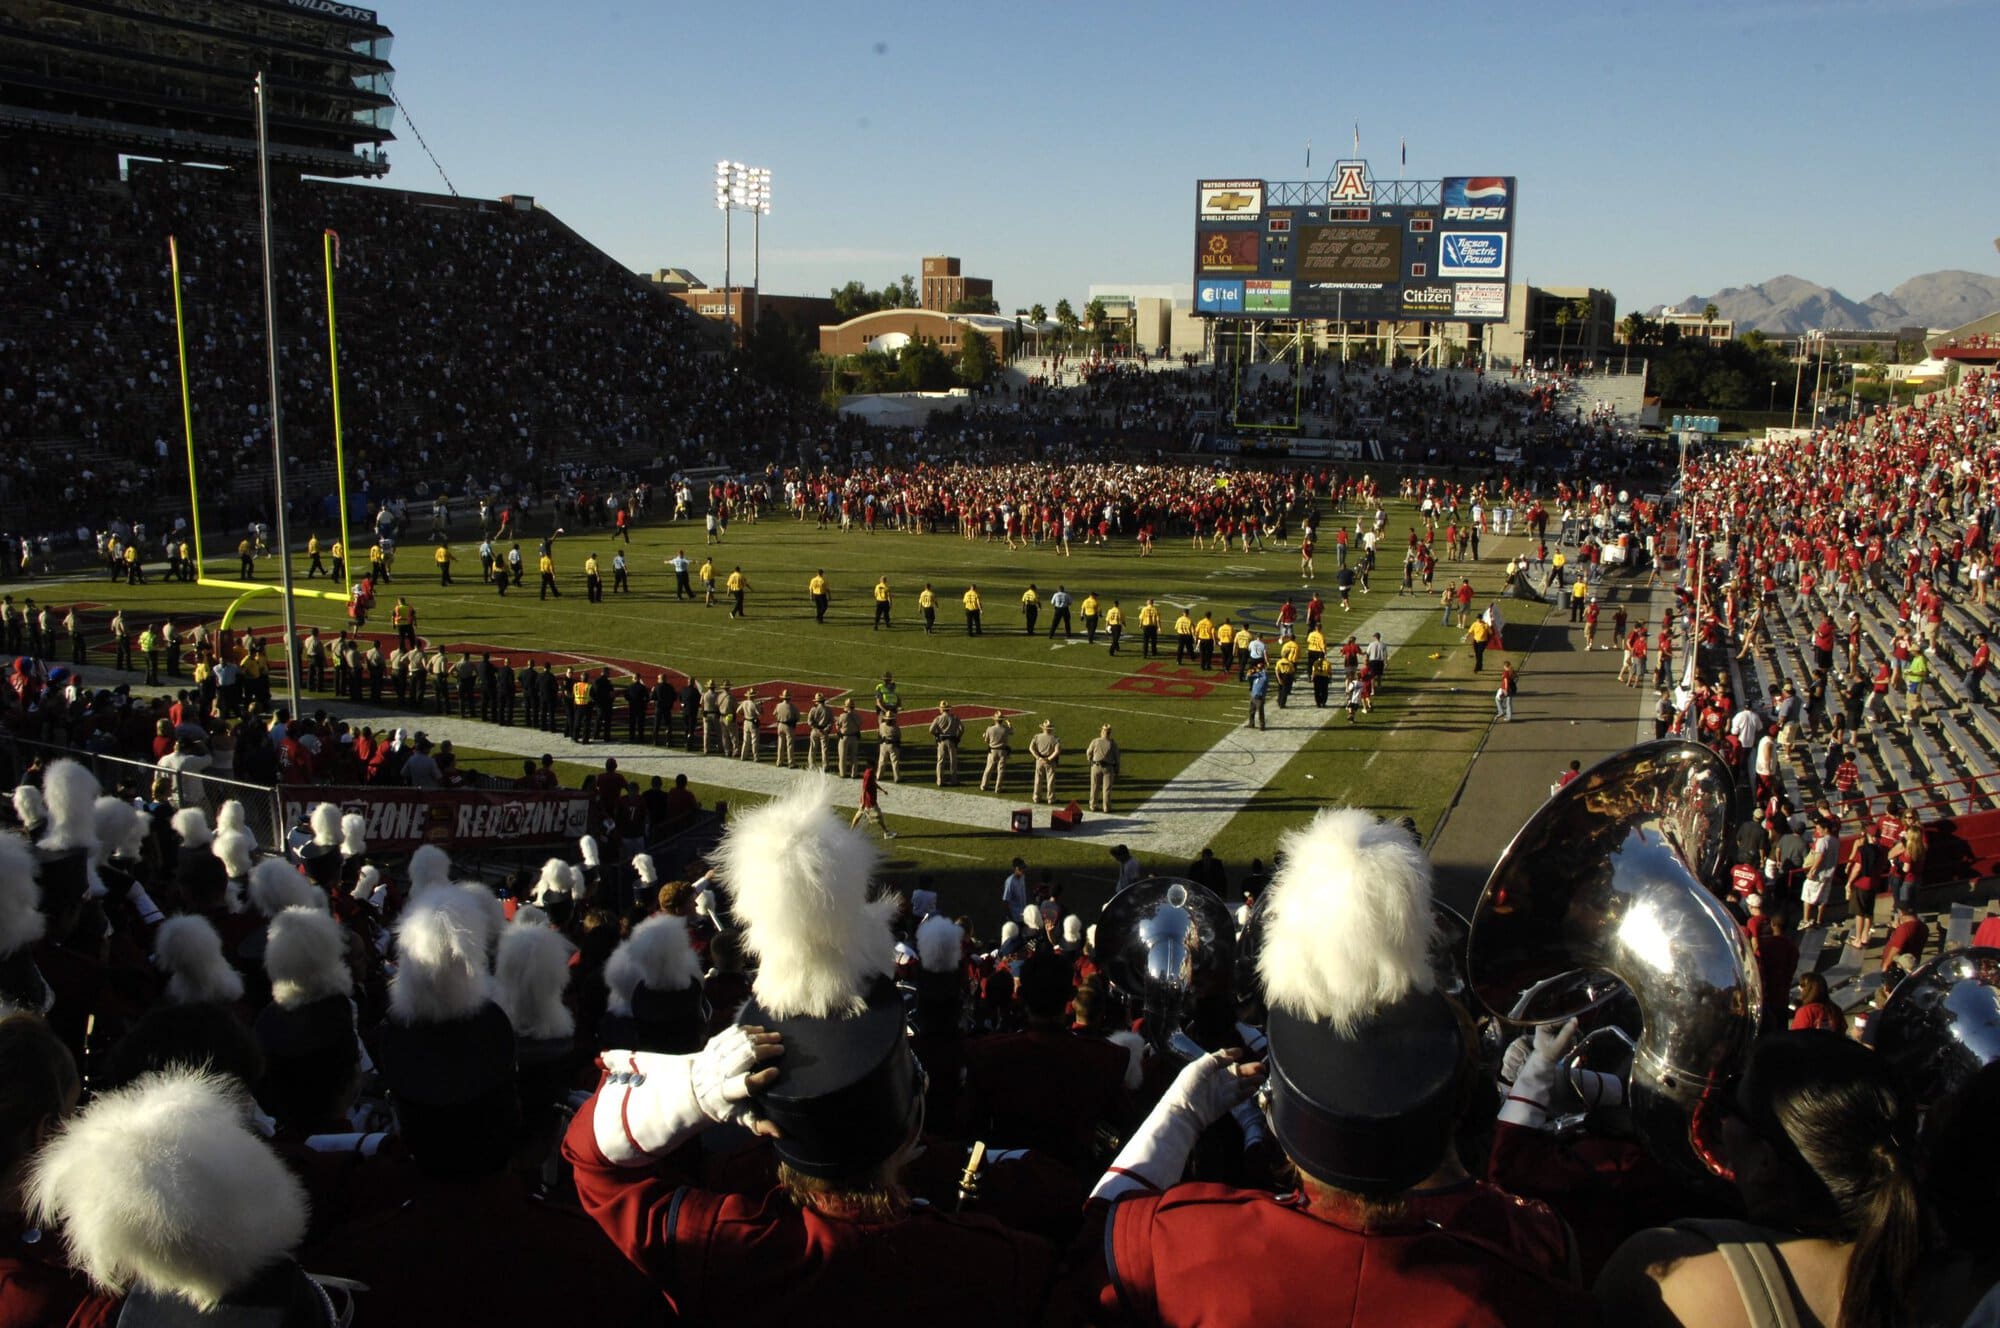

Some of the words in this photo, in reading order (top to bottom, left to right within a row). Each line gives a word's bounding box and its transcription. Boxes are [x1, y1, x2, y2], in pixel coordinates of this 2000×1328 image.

[288, 0, 372, 21] WILDCATS
[1330, 162, 1372, 202] A
[1443, 207, 1506, 220] PEPSI
[1318, 228, 1380, 240] PLEASE
[1307, 243, 1349, 254] STAY
[1351, 243, 1390, 254] OFF
[1458, 238, 1490, 248] Tucson
[1460, 247, 1498, 256] Electric
[1202, 254, 1216, 264] DEL
[1218, 254, 1232, 264] SOL
[1304, 256, 1340, 268] THE
[1341, 256, 1391, 268] FIELD
[1464, 255, 1497, 264] Power
[1403, 289, 1452, 303] Citizen
[1427, 286, 1452, 294] Tucson
[365, 801, 429, 840] ZONE
[455, 802, 504, 839] RED
[521, 800, 568, 837] ZONE
